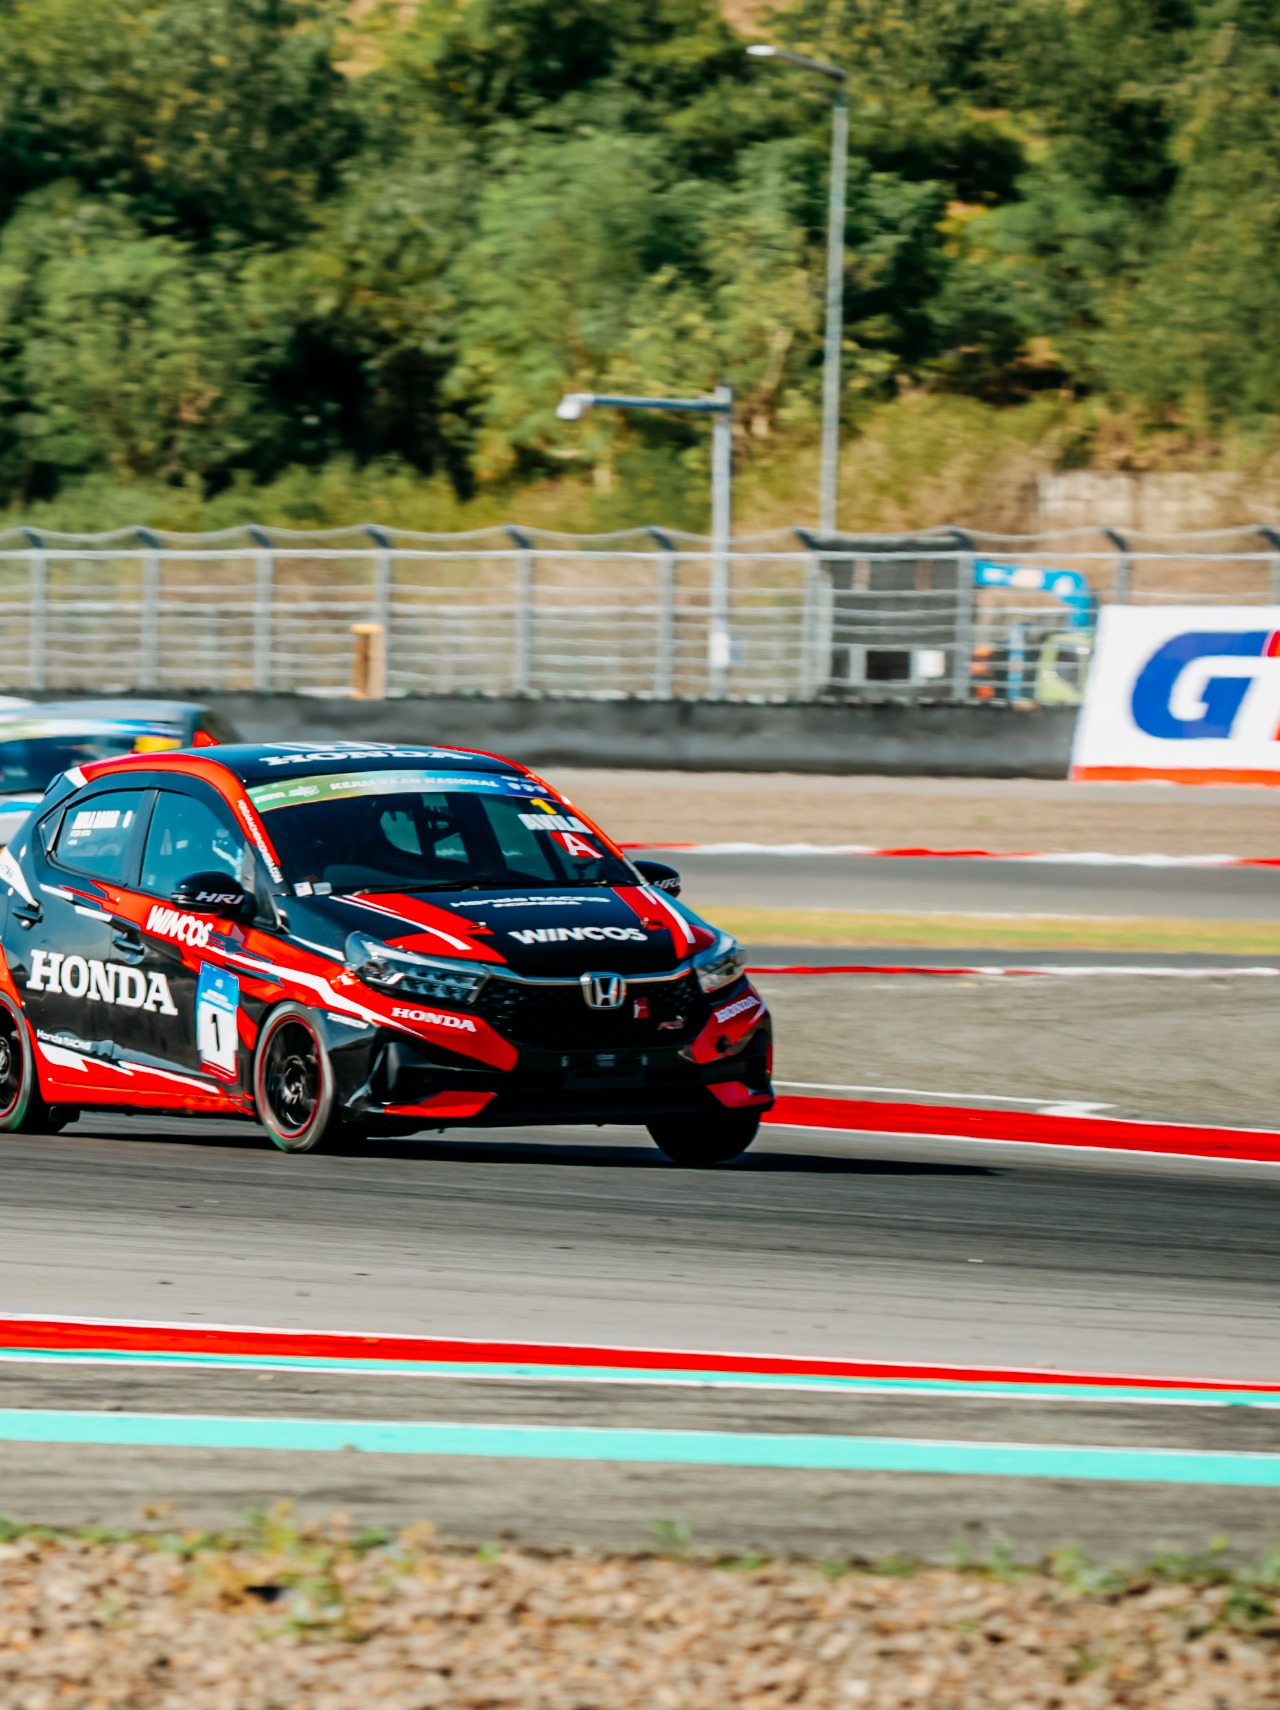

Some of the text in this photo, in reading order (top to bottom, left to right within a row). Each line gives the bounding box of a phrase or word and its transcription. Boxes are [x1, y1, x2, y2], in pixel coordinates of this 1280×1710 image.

[1131, 630, 1280, 742] G
[259, 750, 473, 766] HONDA
[530, 798, 558, 816] 1
[560, 832, 605, 859] A
[146, 904, 214, 948] WINCOS
[507, 926, 649, 945] WINCOS
[26, 949, 179, 1017] HONDA
[210, 1012, 221, 1053] 1
[390, 1007, 478, 1033] HONDA
